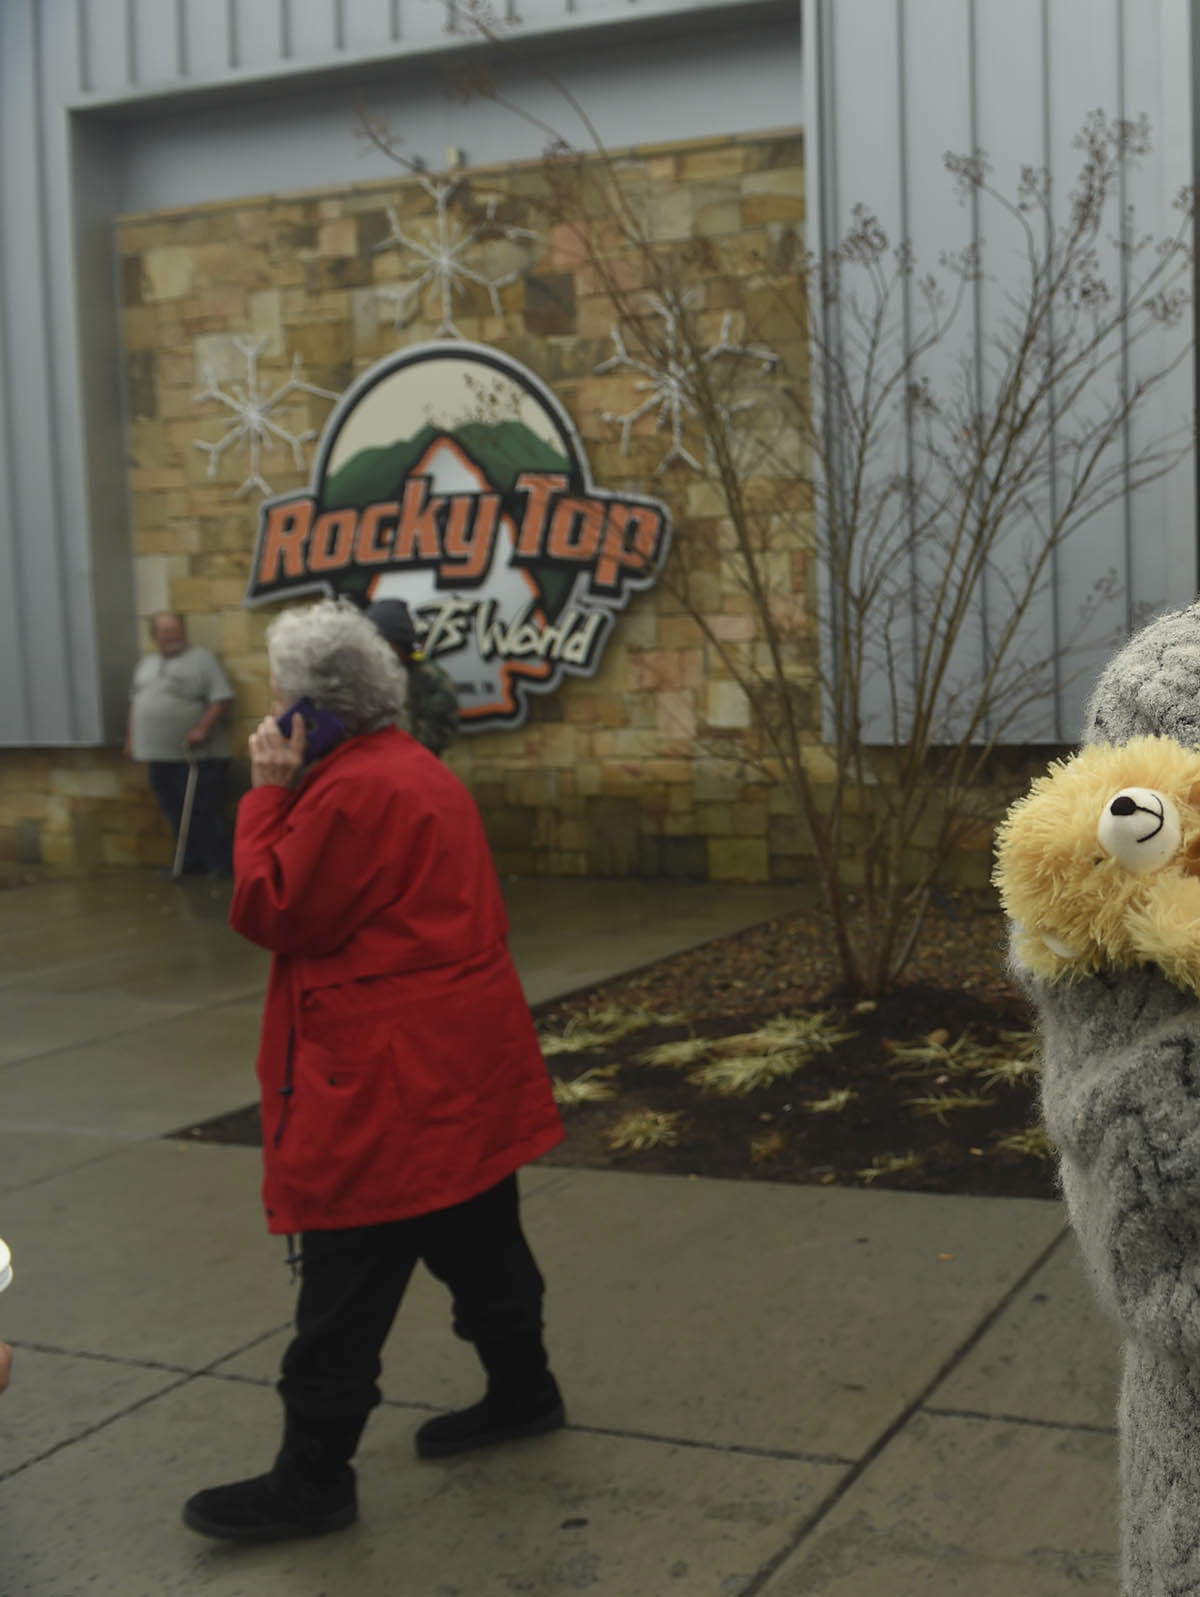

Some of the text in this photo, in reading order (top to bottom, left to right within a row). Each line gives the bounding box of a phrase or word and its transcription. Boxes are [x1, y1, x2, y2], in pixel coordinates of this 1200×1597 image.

[259, 473, 660, 587] Rocky Top
[475, 601, 602, 665] World
